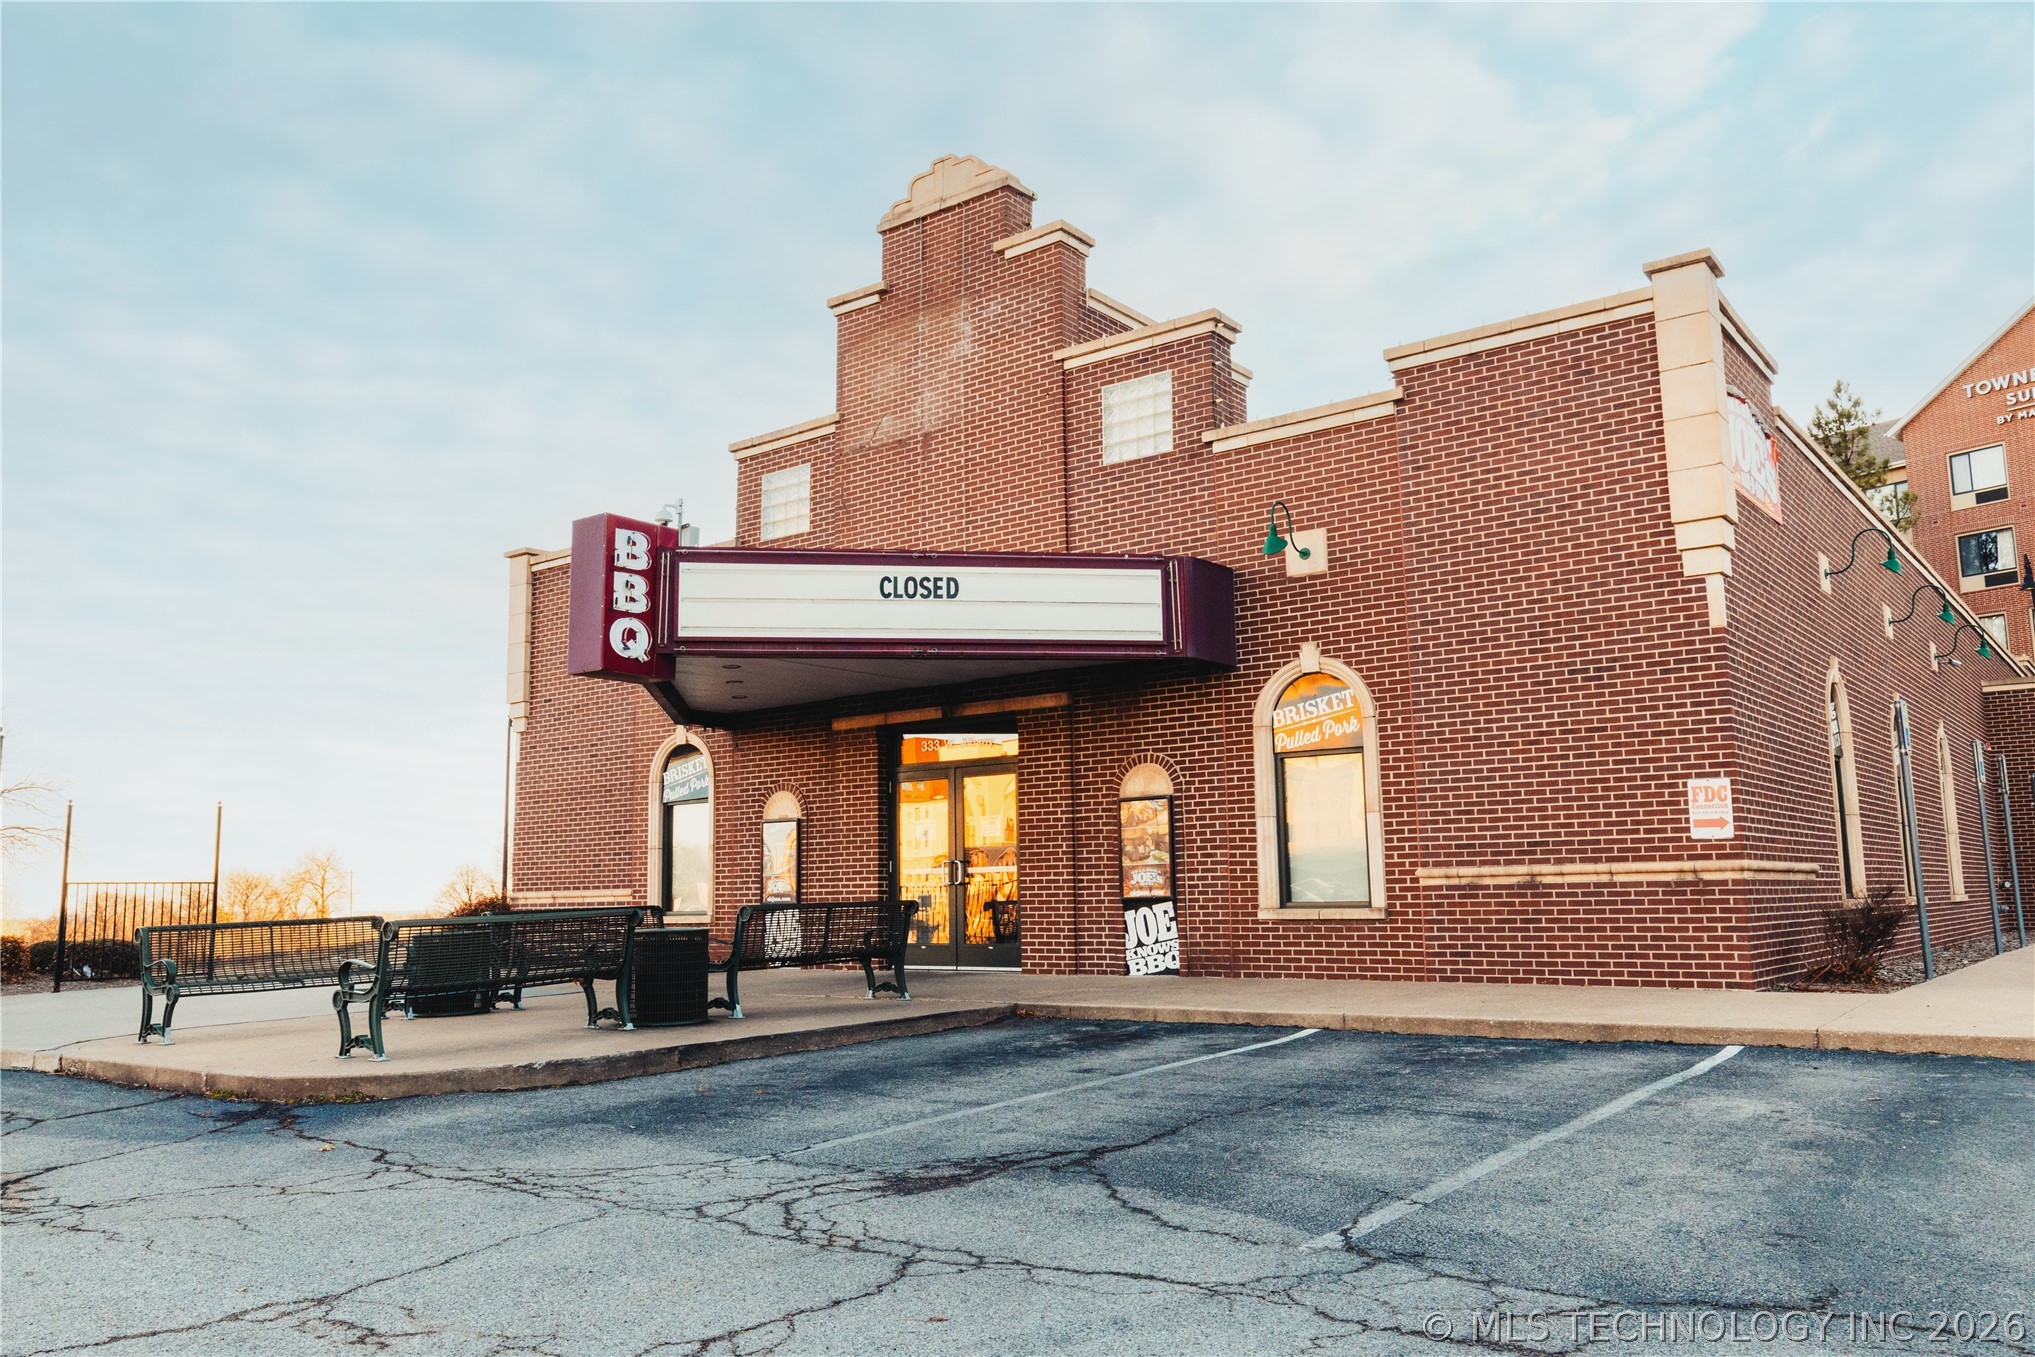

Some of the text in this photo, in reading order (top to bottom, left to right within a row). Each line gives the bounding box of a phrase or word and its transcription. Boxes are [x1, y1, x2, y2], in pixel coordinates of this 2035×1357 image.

[1996, 413, 2013, 425] BY
[609, 528, 653, 663] BBQ
[879, 576, 960, 599] CLOSED
[1273, 689, 1355, 728] BRISKET
[1275, 716, 1360, 752] Pulled Pork
[921, 740, 941, 752] 333
[663, 756, 708, 785] BRISKET
[663, 782, 690, 803] Pulled
[1691, 785, 1728, 803] FDC
[1124, 901, 1178, 949] JOE
[1126, 939, 1179, 960] KNOWS
